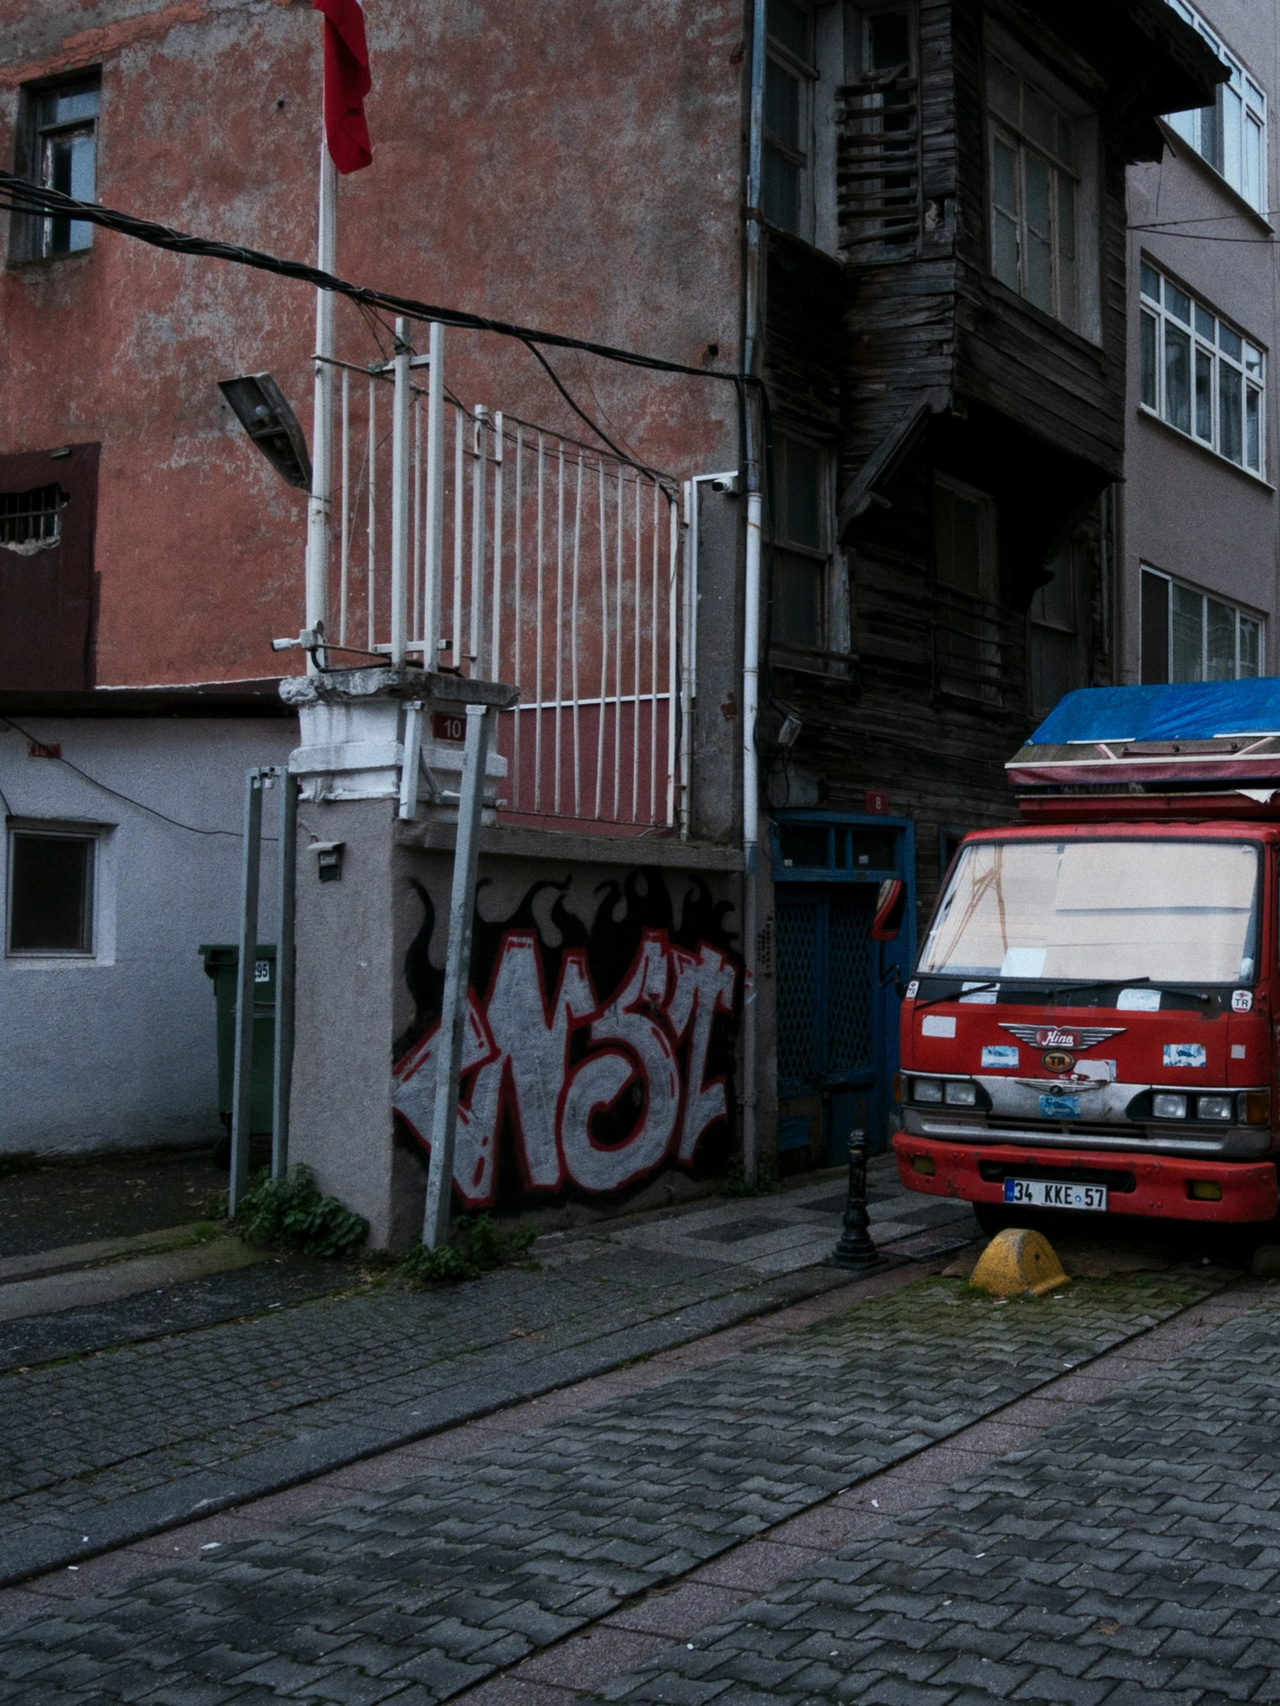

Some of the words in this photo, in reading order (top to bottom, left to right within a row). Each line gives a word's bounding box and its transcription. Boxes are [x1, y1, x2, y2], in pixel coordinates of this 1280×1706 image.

[443, 718, 462, 739] 10
[875, 796, 882, 811] 8
[254, 963, 268, 978] 95
[1234, 997, 1249, 1009] TR
[1041, 1030, 1074, 1047] Hino
[1049, 1056, 1065, 1067] TR
[1014, 1182, 1033, 1202] 34
[1045, 1184, 1073, 1205] KKE
[1084, 1188, 1104, 1207] 57
